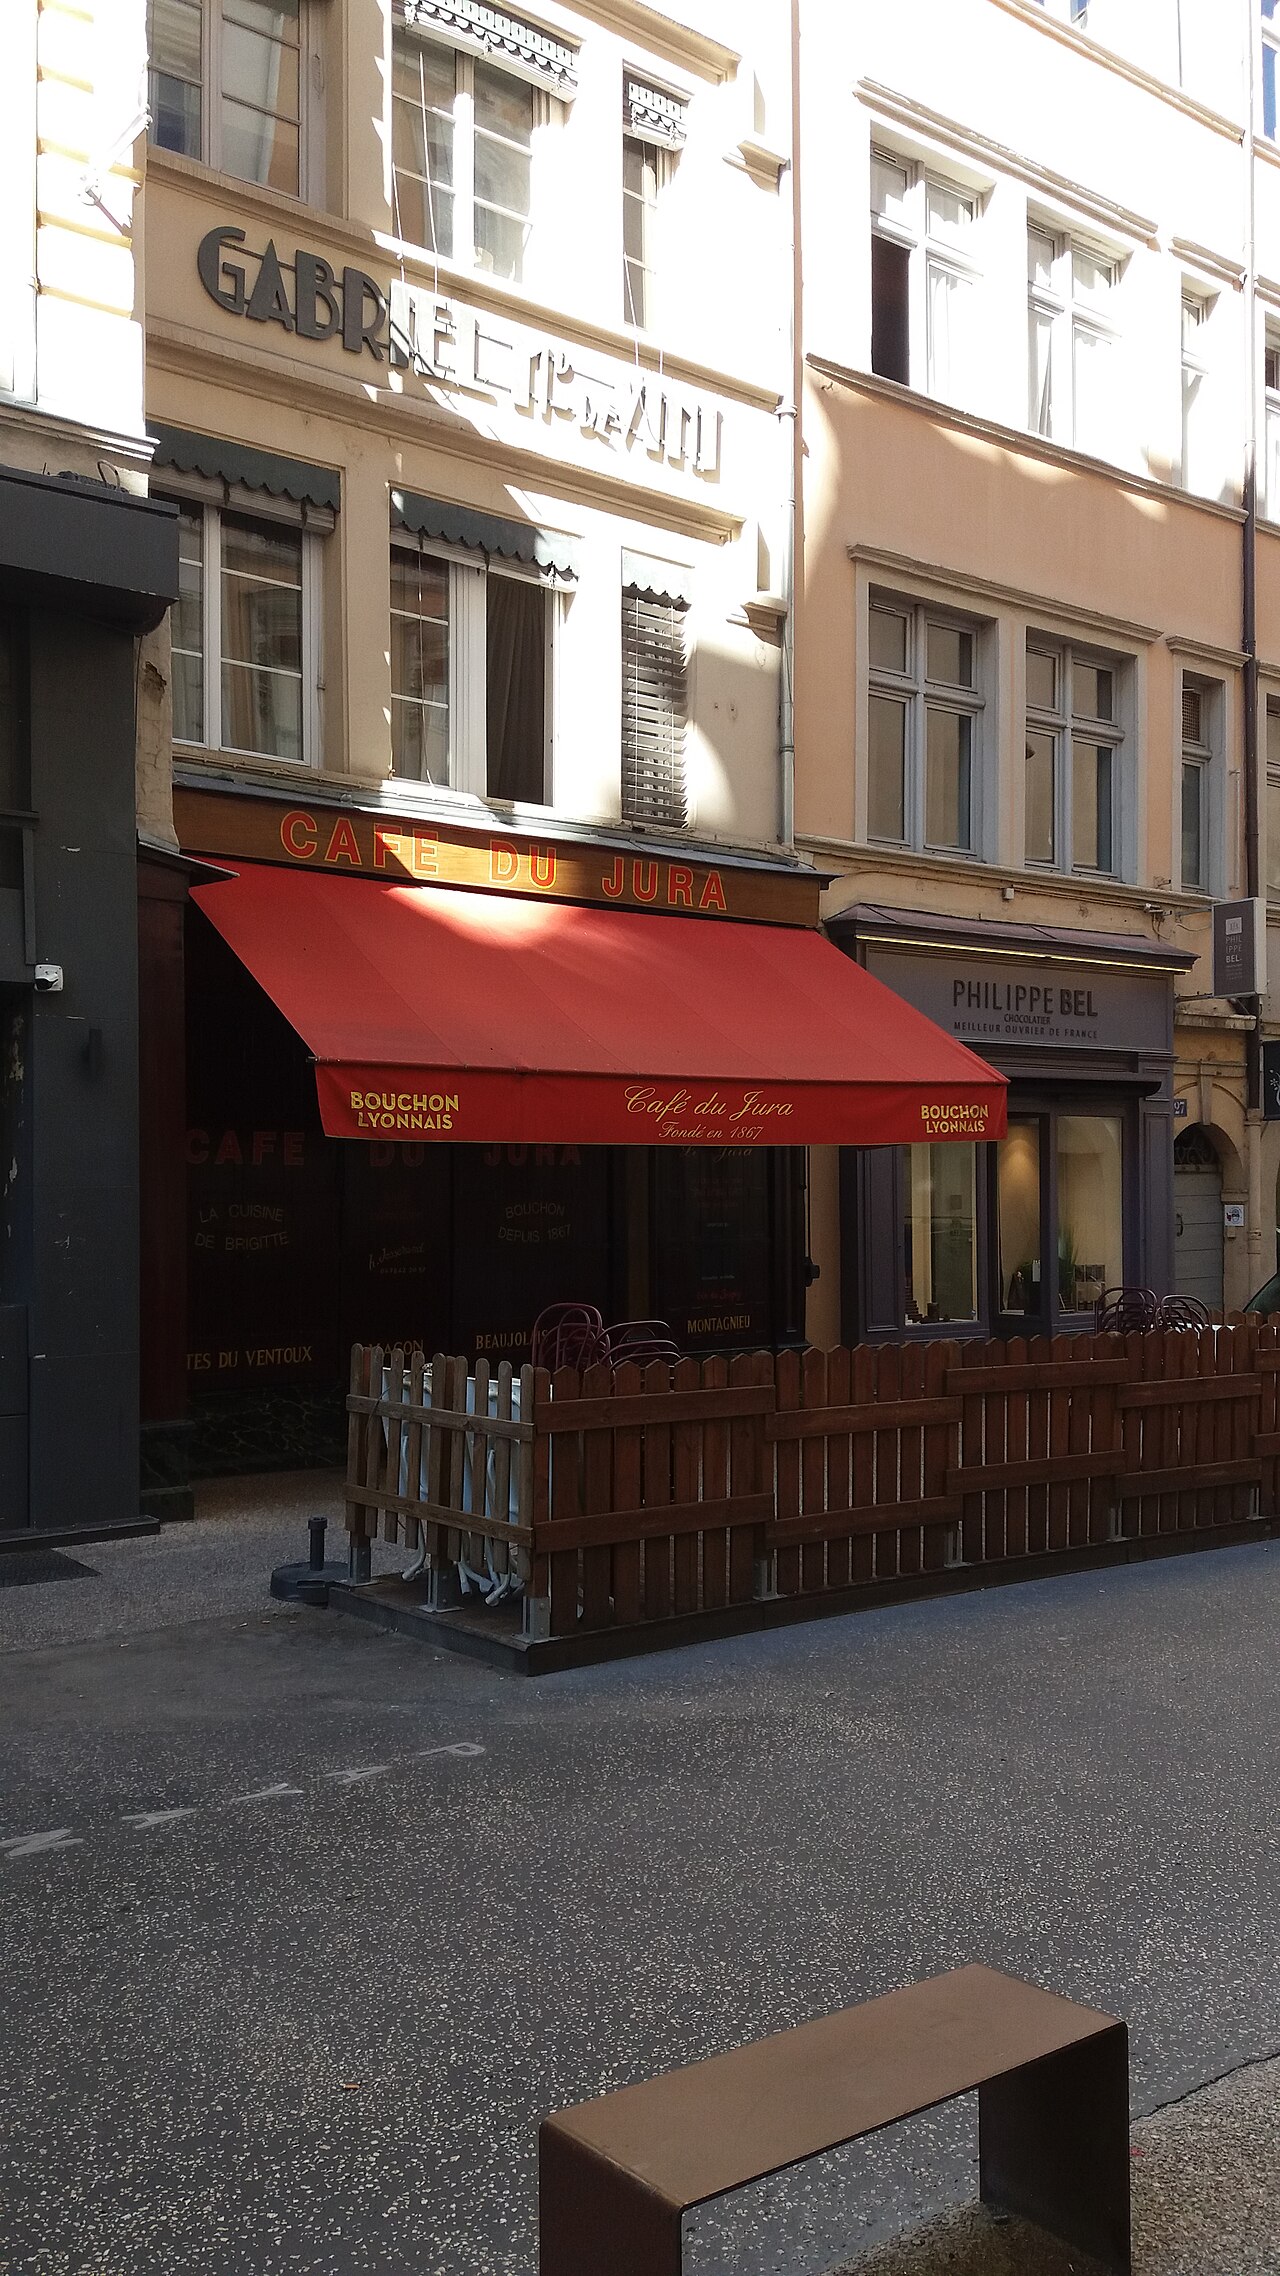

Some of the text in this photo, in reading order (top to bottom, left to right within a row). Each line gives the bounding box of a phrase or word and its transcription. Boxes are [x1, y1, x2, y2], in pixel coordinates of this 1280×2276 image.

[280, 810, 728, 911] CAFE DU JURA
[952, 979, 1098, 1018] PHILIPPE BEL
[1003, 1013, 1051, 1026] CHOCOLATIER
[953, 1021, 1098, 1040] MEILLEUR OUVRIER DE FRANCE
[350, 1090, 460, 1113] BOUCHON
[624, 1085, 794, 1121] Café du Jura
[357, 1110, 454, 1131] LYONNAIS
[921, 1104, 988, 1121] BOUCHON
[658, 1120, 764, 1140] Fondé en 1867
[925, 1119, 986, 1135] LYONNAIS
[185, 1128, 306, 1166] CAFE
[199, 1202, 285, 1224] LA CUISINE
[504, 1201, 566, 1220] BOUCHON
[194, 1230, 289, 1252] DE BRIGITTE
[497, 1223, 572, 1244] DEPUIS 1867
[687, 1315, 752, 1335] MONTAGNIEU
[218, 1350, 239, 1368] DU
[246, 1345, 313, 1367] VENTOUX
